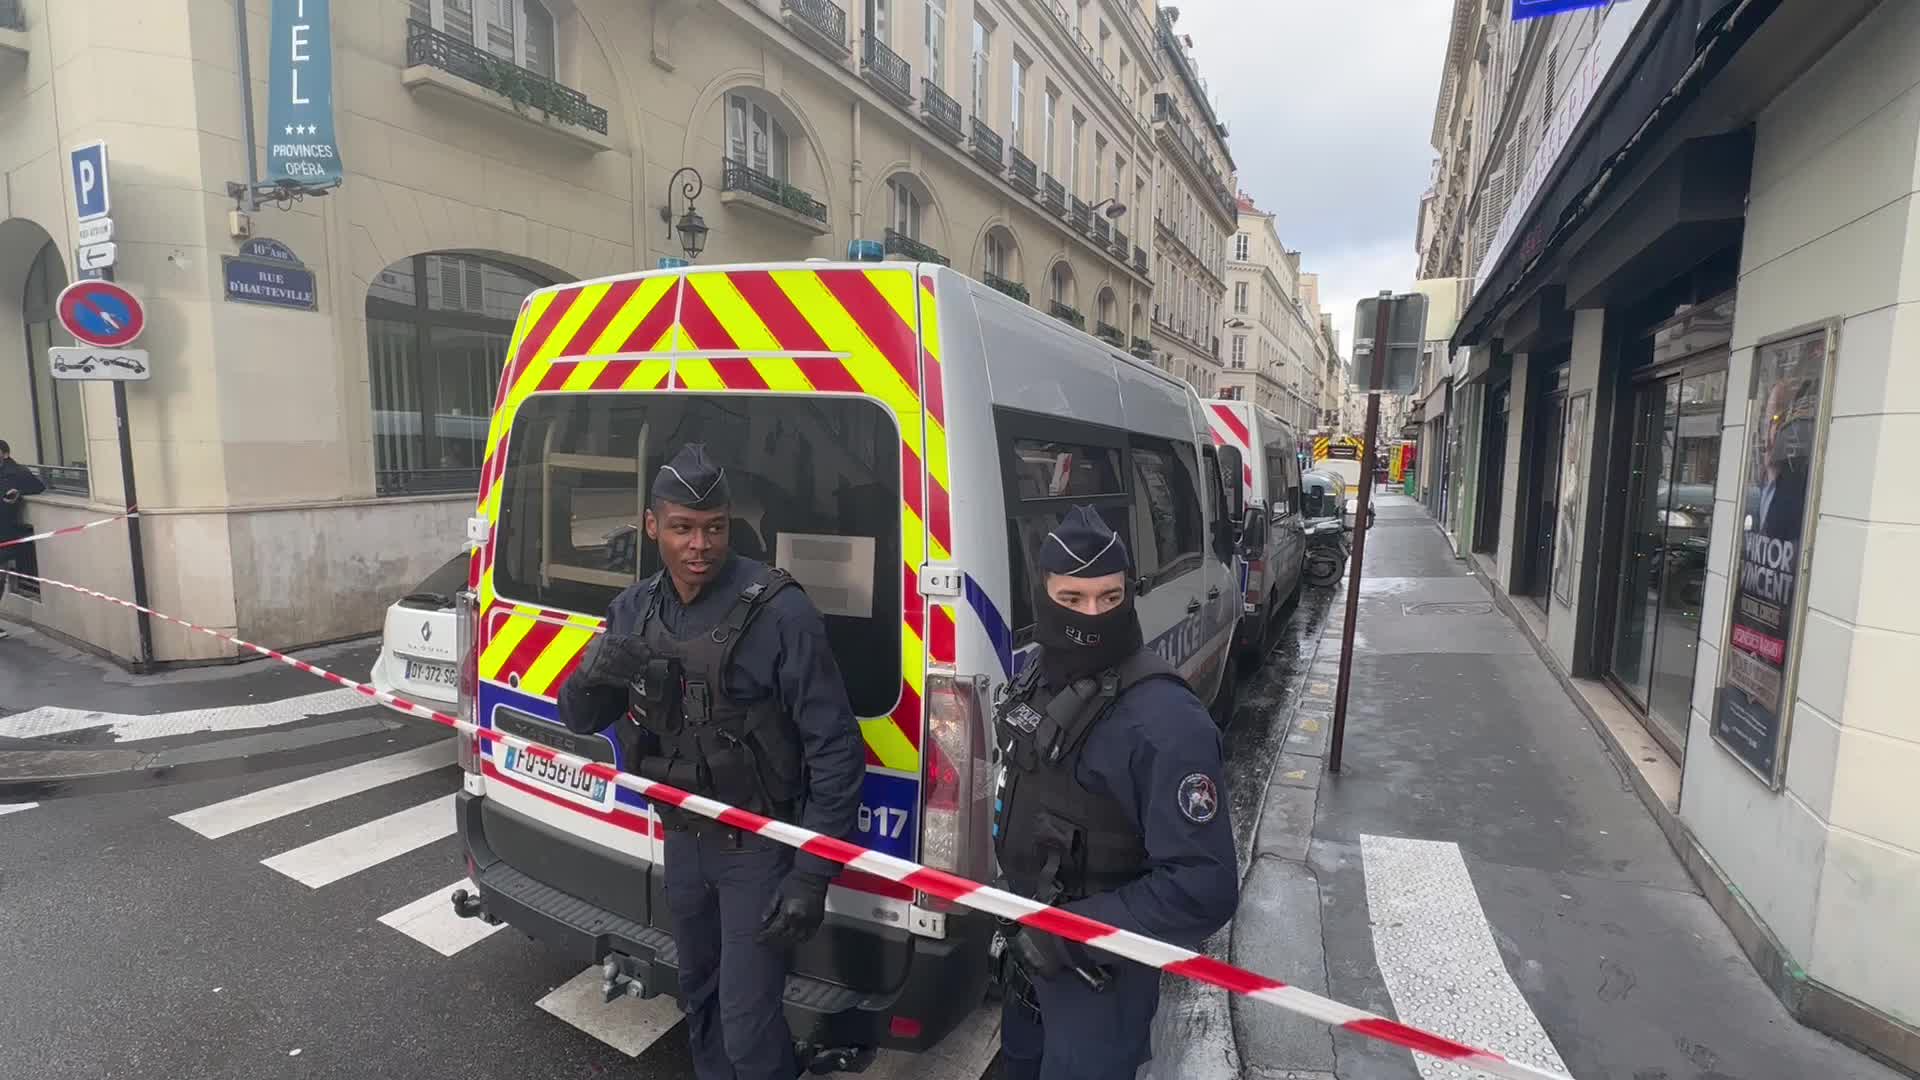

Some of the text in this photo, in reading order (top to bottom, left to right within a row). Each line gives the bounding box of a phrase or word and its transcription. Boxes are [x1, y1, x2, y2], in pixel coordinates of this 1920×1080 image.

[273, 144, 333, 158] PROVINCES
[285, 160, 326, 176] OPÉRA
[80, 160, 95, 205] P
[229, 280, 312, 302] D'HAUTEVILLE
[259, 271, 285, 284] RUE
[1744, 529, 1793, 574] VIKTOR
[1741, 560, 1793, 605] VINCENT
[873, 806, 908, 839] 17
